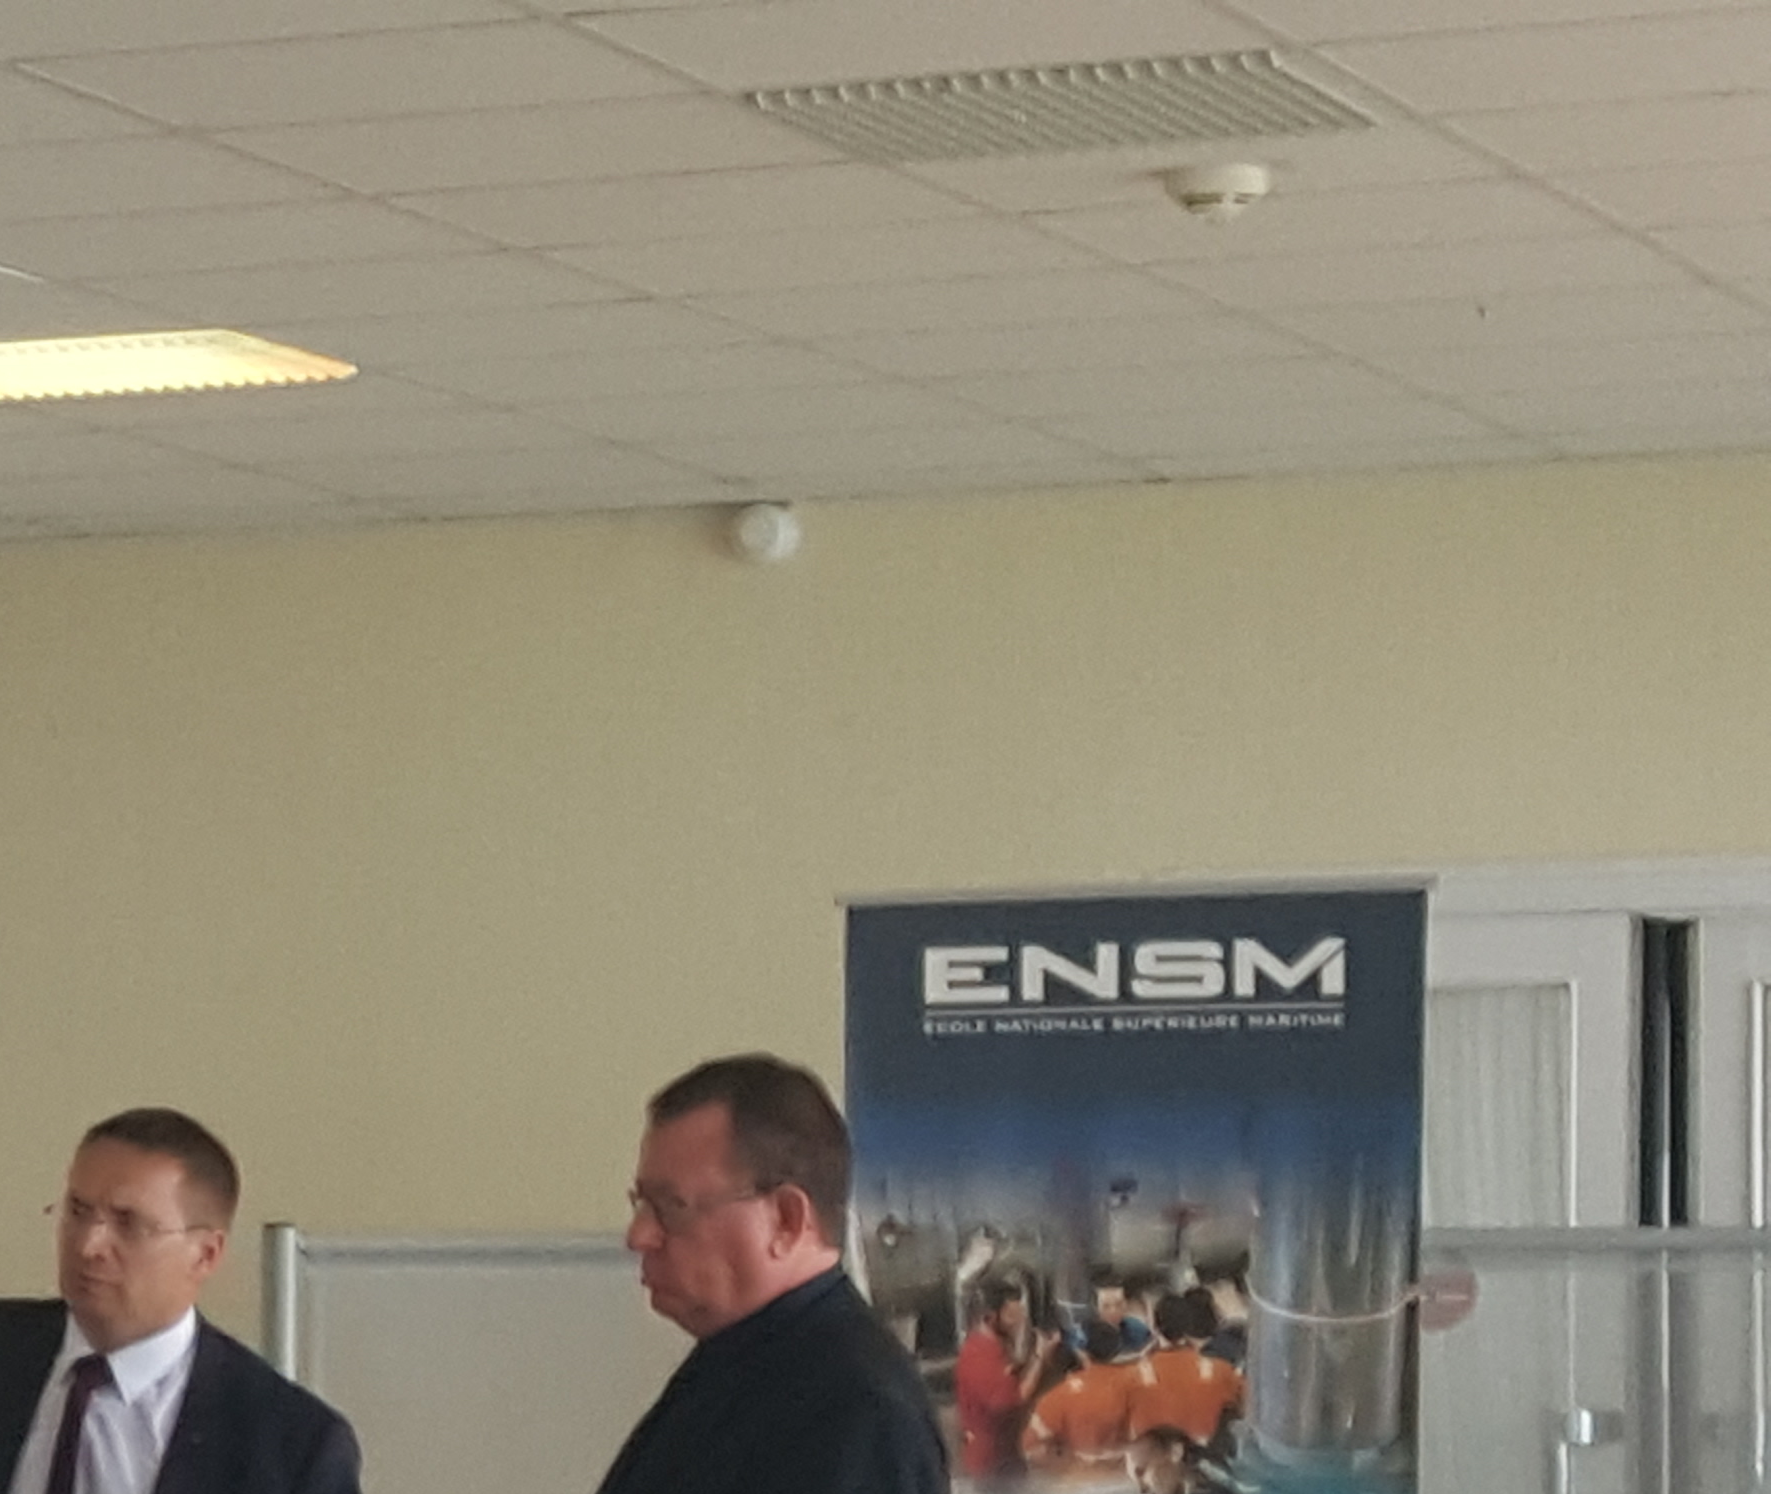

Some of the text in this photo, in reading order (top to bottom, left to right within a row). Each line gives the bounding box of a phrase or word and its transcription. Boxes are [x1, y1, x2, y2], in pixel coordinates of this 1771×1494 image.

[924, 936, 1347, 1005] ENSM
[923, 1018, 987, 1035] ECOLE
[994, 1016, 1106, 1033] NATIONALE
[1247, 1011, 1345, 1029] MARITIME
